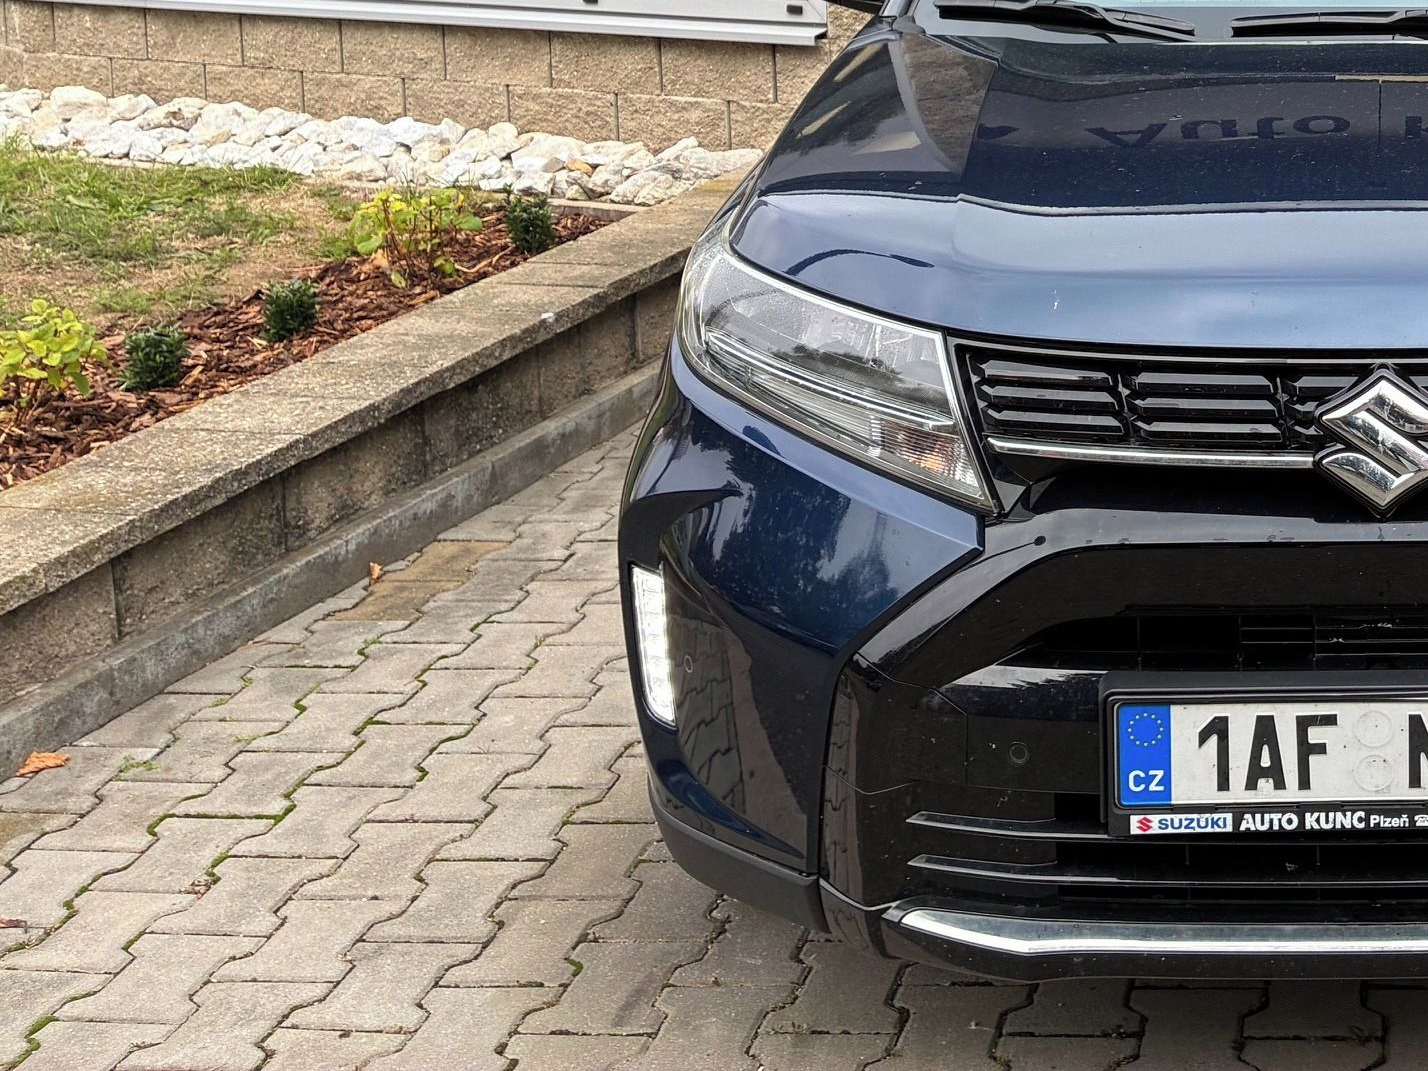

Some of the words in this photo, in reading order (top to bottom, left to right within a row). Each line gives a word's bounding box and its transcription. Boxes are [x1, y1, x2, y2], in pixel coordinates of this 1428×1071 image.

[1196, 713, 1340, 792] 1AF
[1128, 769, 1165, 792] CZ
[1157, 816, 1227, 830] SUZUKI
[1239, 812, 1299, 831] AUTO
[1304, 811, 1367, 830] KUNC
[1370, 814, 1409, 828] Plzeň
